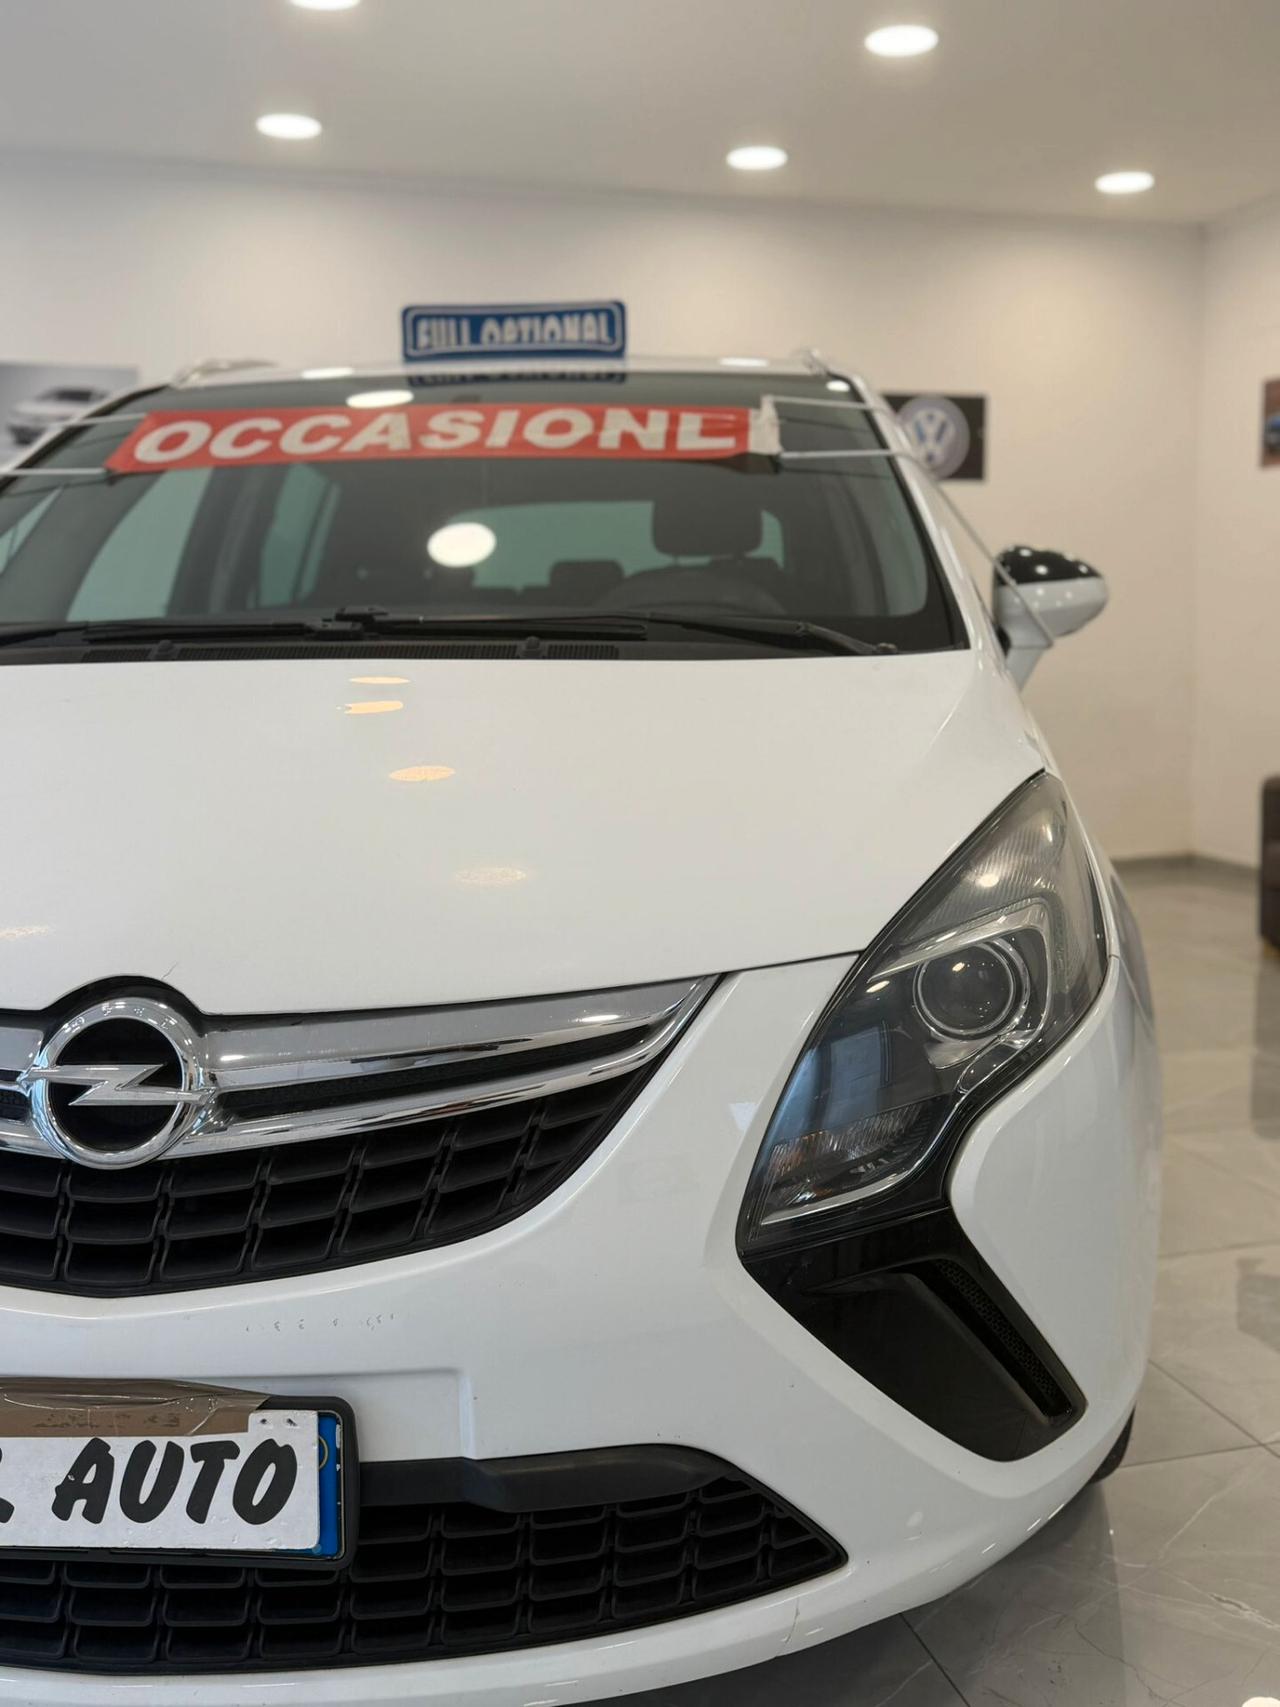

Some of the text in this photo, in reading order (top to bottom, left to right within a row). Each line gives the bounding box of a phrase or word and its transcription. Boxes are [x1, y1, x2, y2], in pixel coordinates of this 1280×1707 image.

[416, 312, 613, 350] FULL OPTIONAL
[51, 1437, 298, 1525] AUTO
